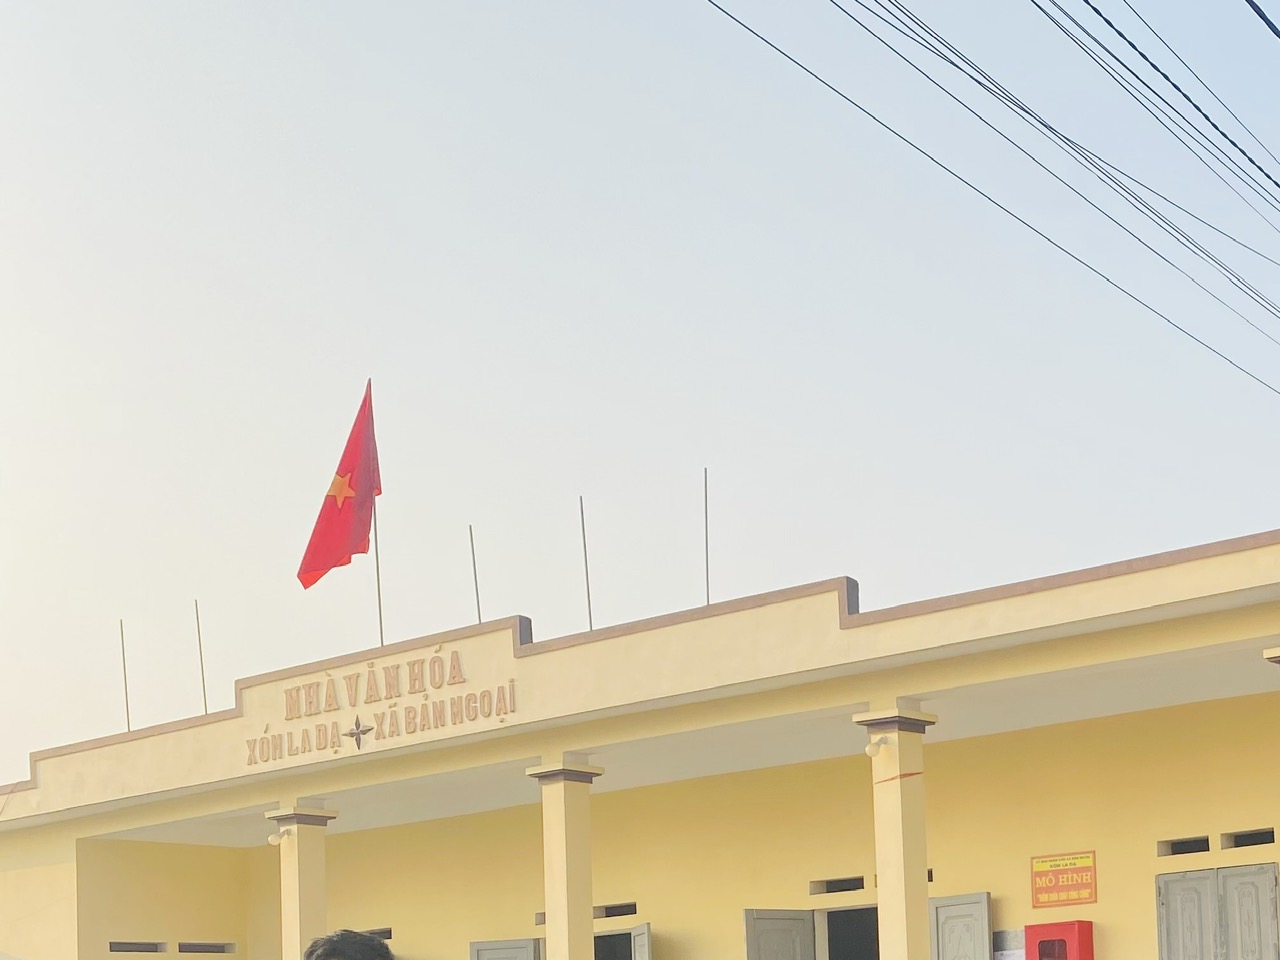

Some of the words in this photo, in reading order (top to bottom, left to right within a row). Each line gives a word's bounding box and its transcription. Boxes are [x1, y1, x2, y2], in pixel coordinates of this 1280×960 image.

[284, 671, 340, 720] NHÀ
[343, 662, 402, 707] VĂN
[407, 643, 466, 694] HÓA
[246, 723, 283, 765] XÓM
[287, 728, 311, 756] LA
[315, 721, 341, 754] DẠ
[374, 702, 400, 740] XÃ
[404, 693, 445, 734] BẢN
[450, 678, 516, 725] NGOẠI
[1035, 872, 1055, 887] MÔ
[1058, 871, 1092, 885] HÌNH
